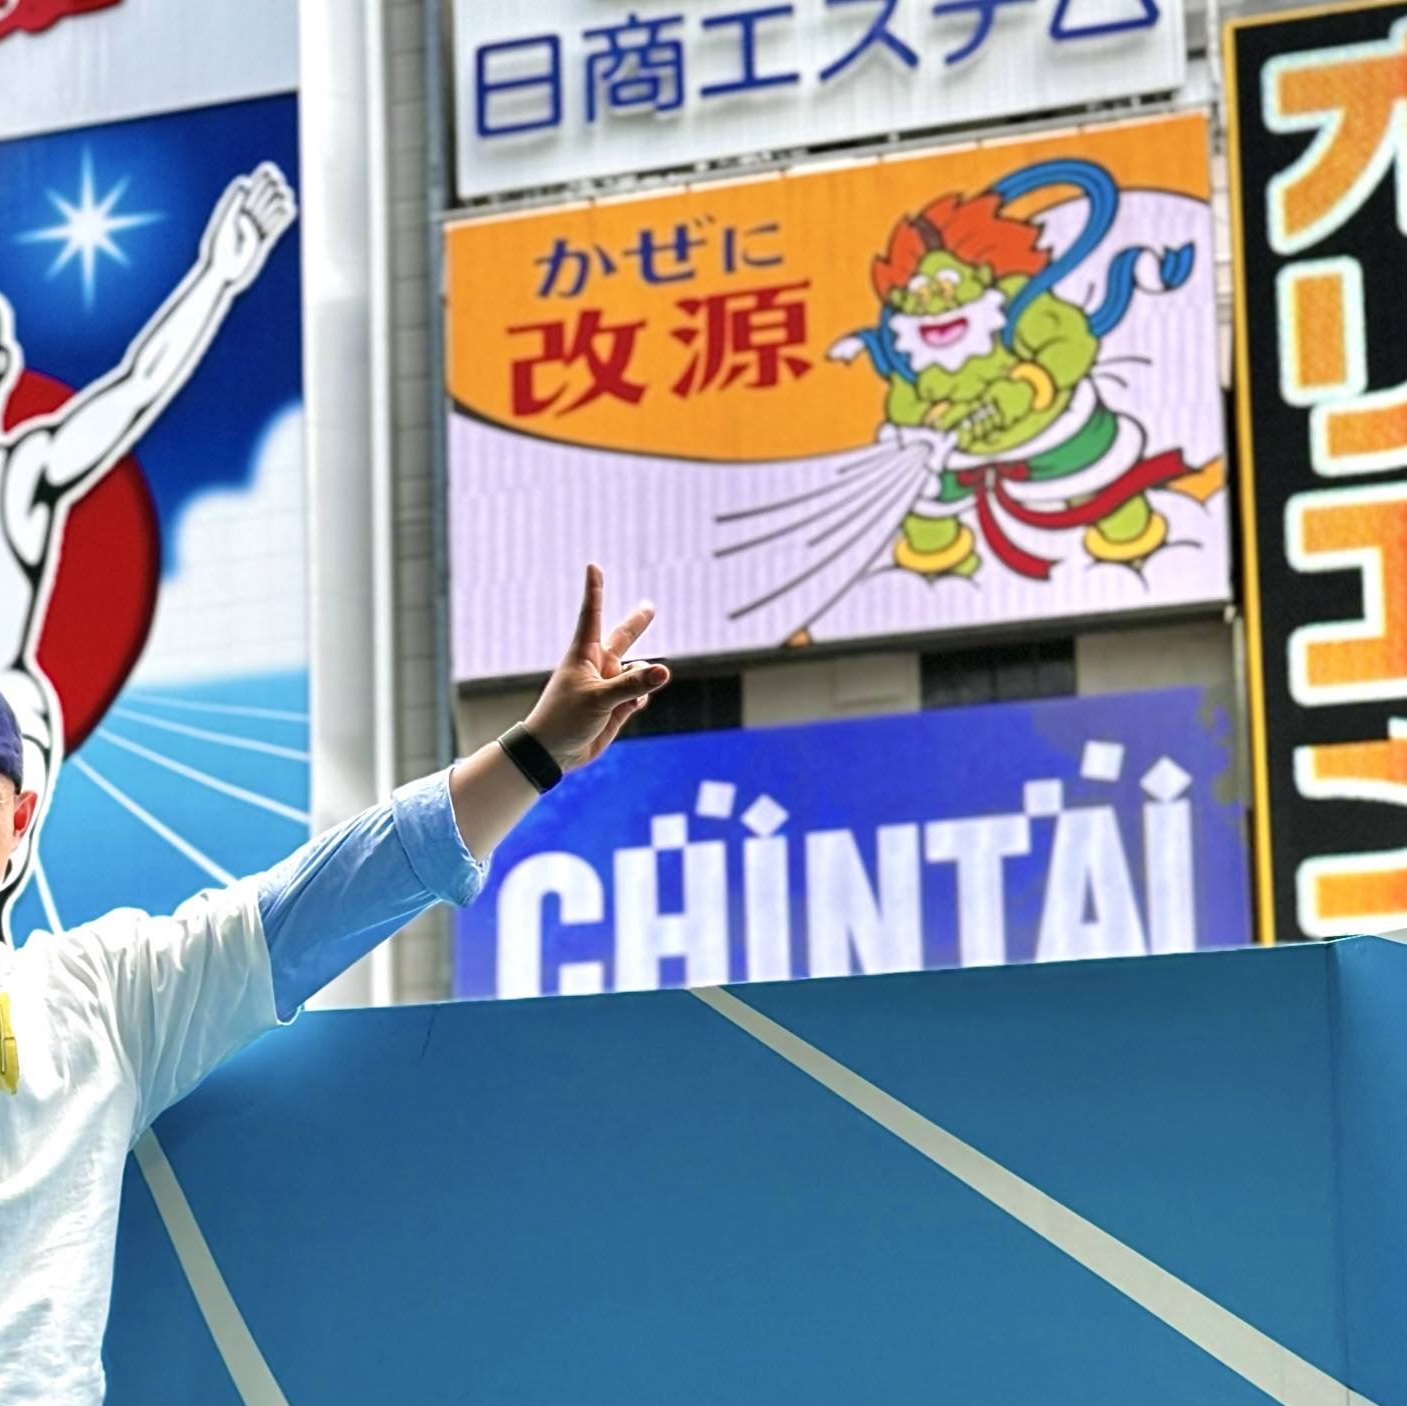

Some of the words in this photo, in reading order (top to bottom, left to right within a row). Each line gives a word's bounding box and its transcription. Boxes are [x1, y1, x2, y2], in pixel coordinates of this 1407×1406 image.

[533, 214, 784, 299] かぜに
[506, 277, 814, 419] 改源
[496, 740, 1192, 1000] CHINTAI
